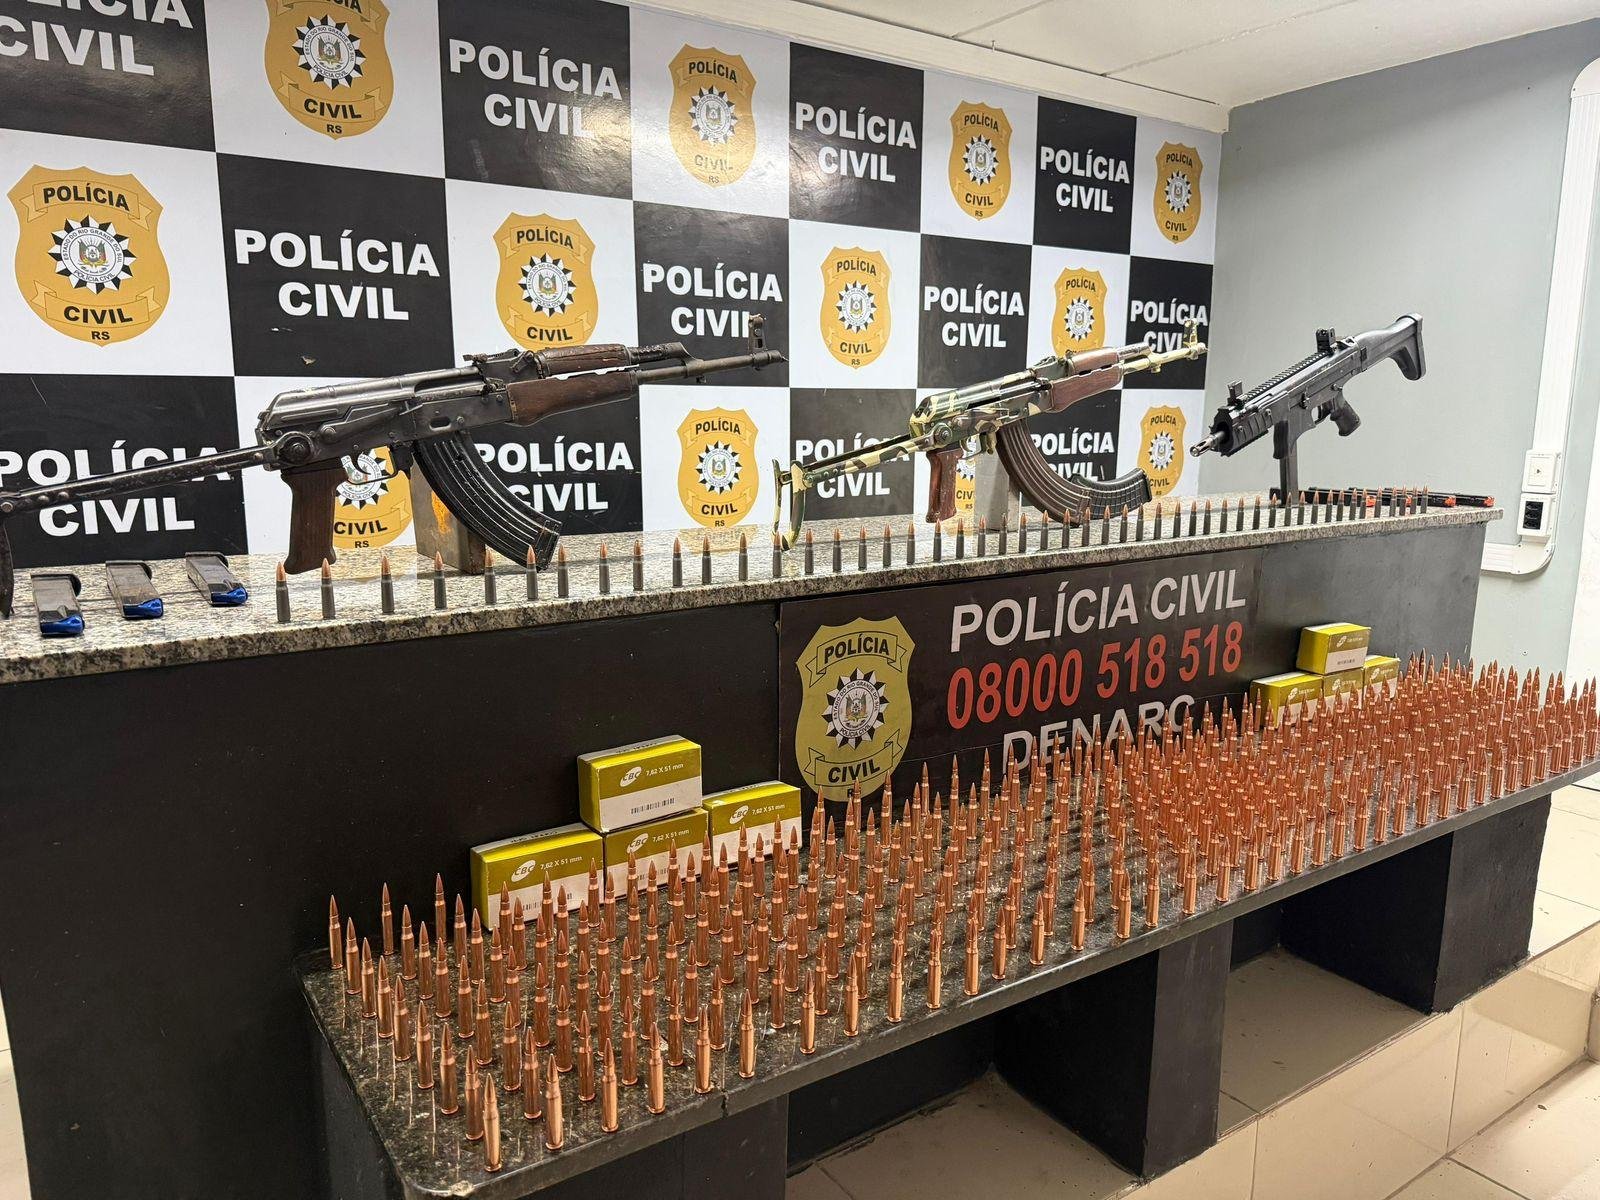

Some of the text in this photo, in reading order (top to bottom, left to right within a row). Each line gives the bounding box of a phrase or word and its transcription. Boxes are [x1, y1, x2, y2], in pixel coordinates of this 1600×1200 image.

[0, 15, 154, 76] CIVIL
[448, 38, 622, 100] POLÍCIA
[688, 60, 738, 83] POLÍCIA
[304, 98, 362, 120] CIVIL
[484, 93, 599, 139] CIVIL
[326, 124, 342, 134] RS
[795, 101, 917, 150] POLÍCIA
[964, 113, 999, 132] POLÍCIA
[817, 146, 896, 183] CIVIL
[1040, 145, 1130, 184] POLÍCIA
[1166, 153, 1193, 168] POLÍCIA
[43, 182, 130, 211] POLÍCIA
[965, 192, 994, 206] CIVIL
[1056, 182, 1114, 213] CIVIL
[69, 232, 78, 240] DO
[90, 229, 115, 243] GRANDE
[1165, 220, 1187, 232] CIVIL
[516, 226, 574, 250] POLÍCIA
[234, 228, 440, 277] POLÍCIA
[74, 270, 115, 282] POLÍCIA CIVIL
[836, 256, 877, 277] POLÍCIA
[642, 262, 783, 302] POLÍCIA
[1065, 276, 1097, 293] POLÍCIA
[278, 282, 409, 321] CIVIL
[924, 283, 1025, 316] POLÍCIA
[63, 305, 134, 325] CIVIL
[1130, 298, 1208, 326] POLÍCIA
[91, 330, 110, 341] RS
[527, 326, 573, 342] CIVIL
[942, 321, 1007, 348] CIVIL
[1144, 331, 1183, 352] CIVI
[839, 340, 872, 354] CIVIL
[695, 417, 741, 436] POLÍCIA
[1150, 414, 1176, 426] POLÍCIA
[1030, 428, 1114, 456] POLÍCIA
[474, 435, 634, 473] POLÍCIA
[816, 472, 890, 499] CIVIL
[956, 490, 973, 500] CIV
[38, 497, 196, 537] CIVIL
[700, 502, 738, 516] CIVIL
[334, 520, 388, 535] CIVIL
[714, 519, 726, 528] RS
[354, 540, 370, 548] RS
[950, 568, 1246, 652] POLÍCIA CIVIL
[824, 633, 890, 664] POLÍCIA
[948, 620, 1243, 730] 08000 518 518
[1002, 694, 1195, 774] DENARC
[828, 758, 880, 783] CIVIL
[514, 864, 535, 876] CBC
